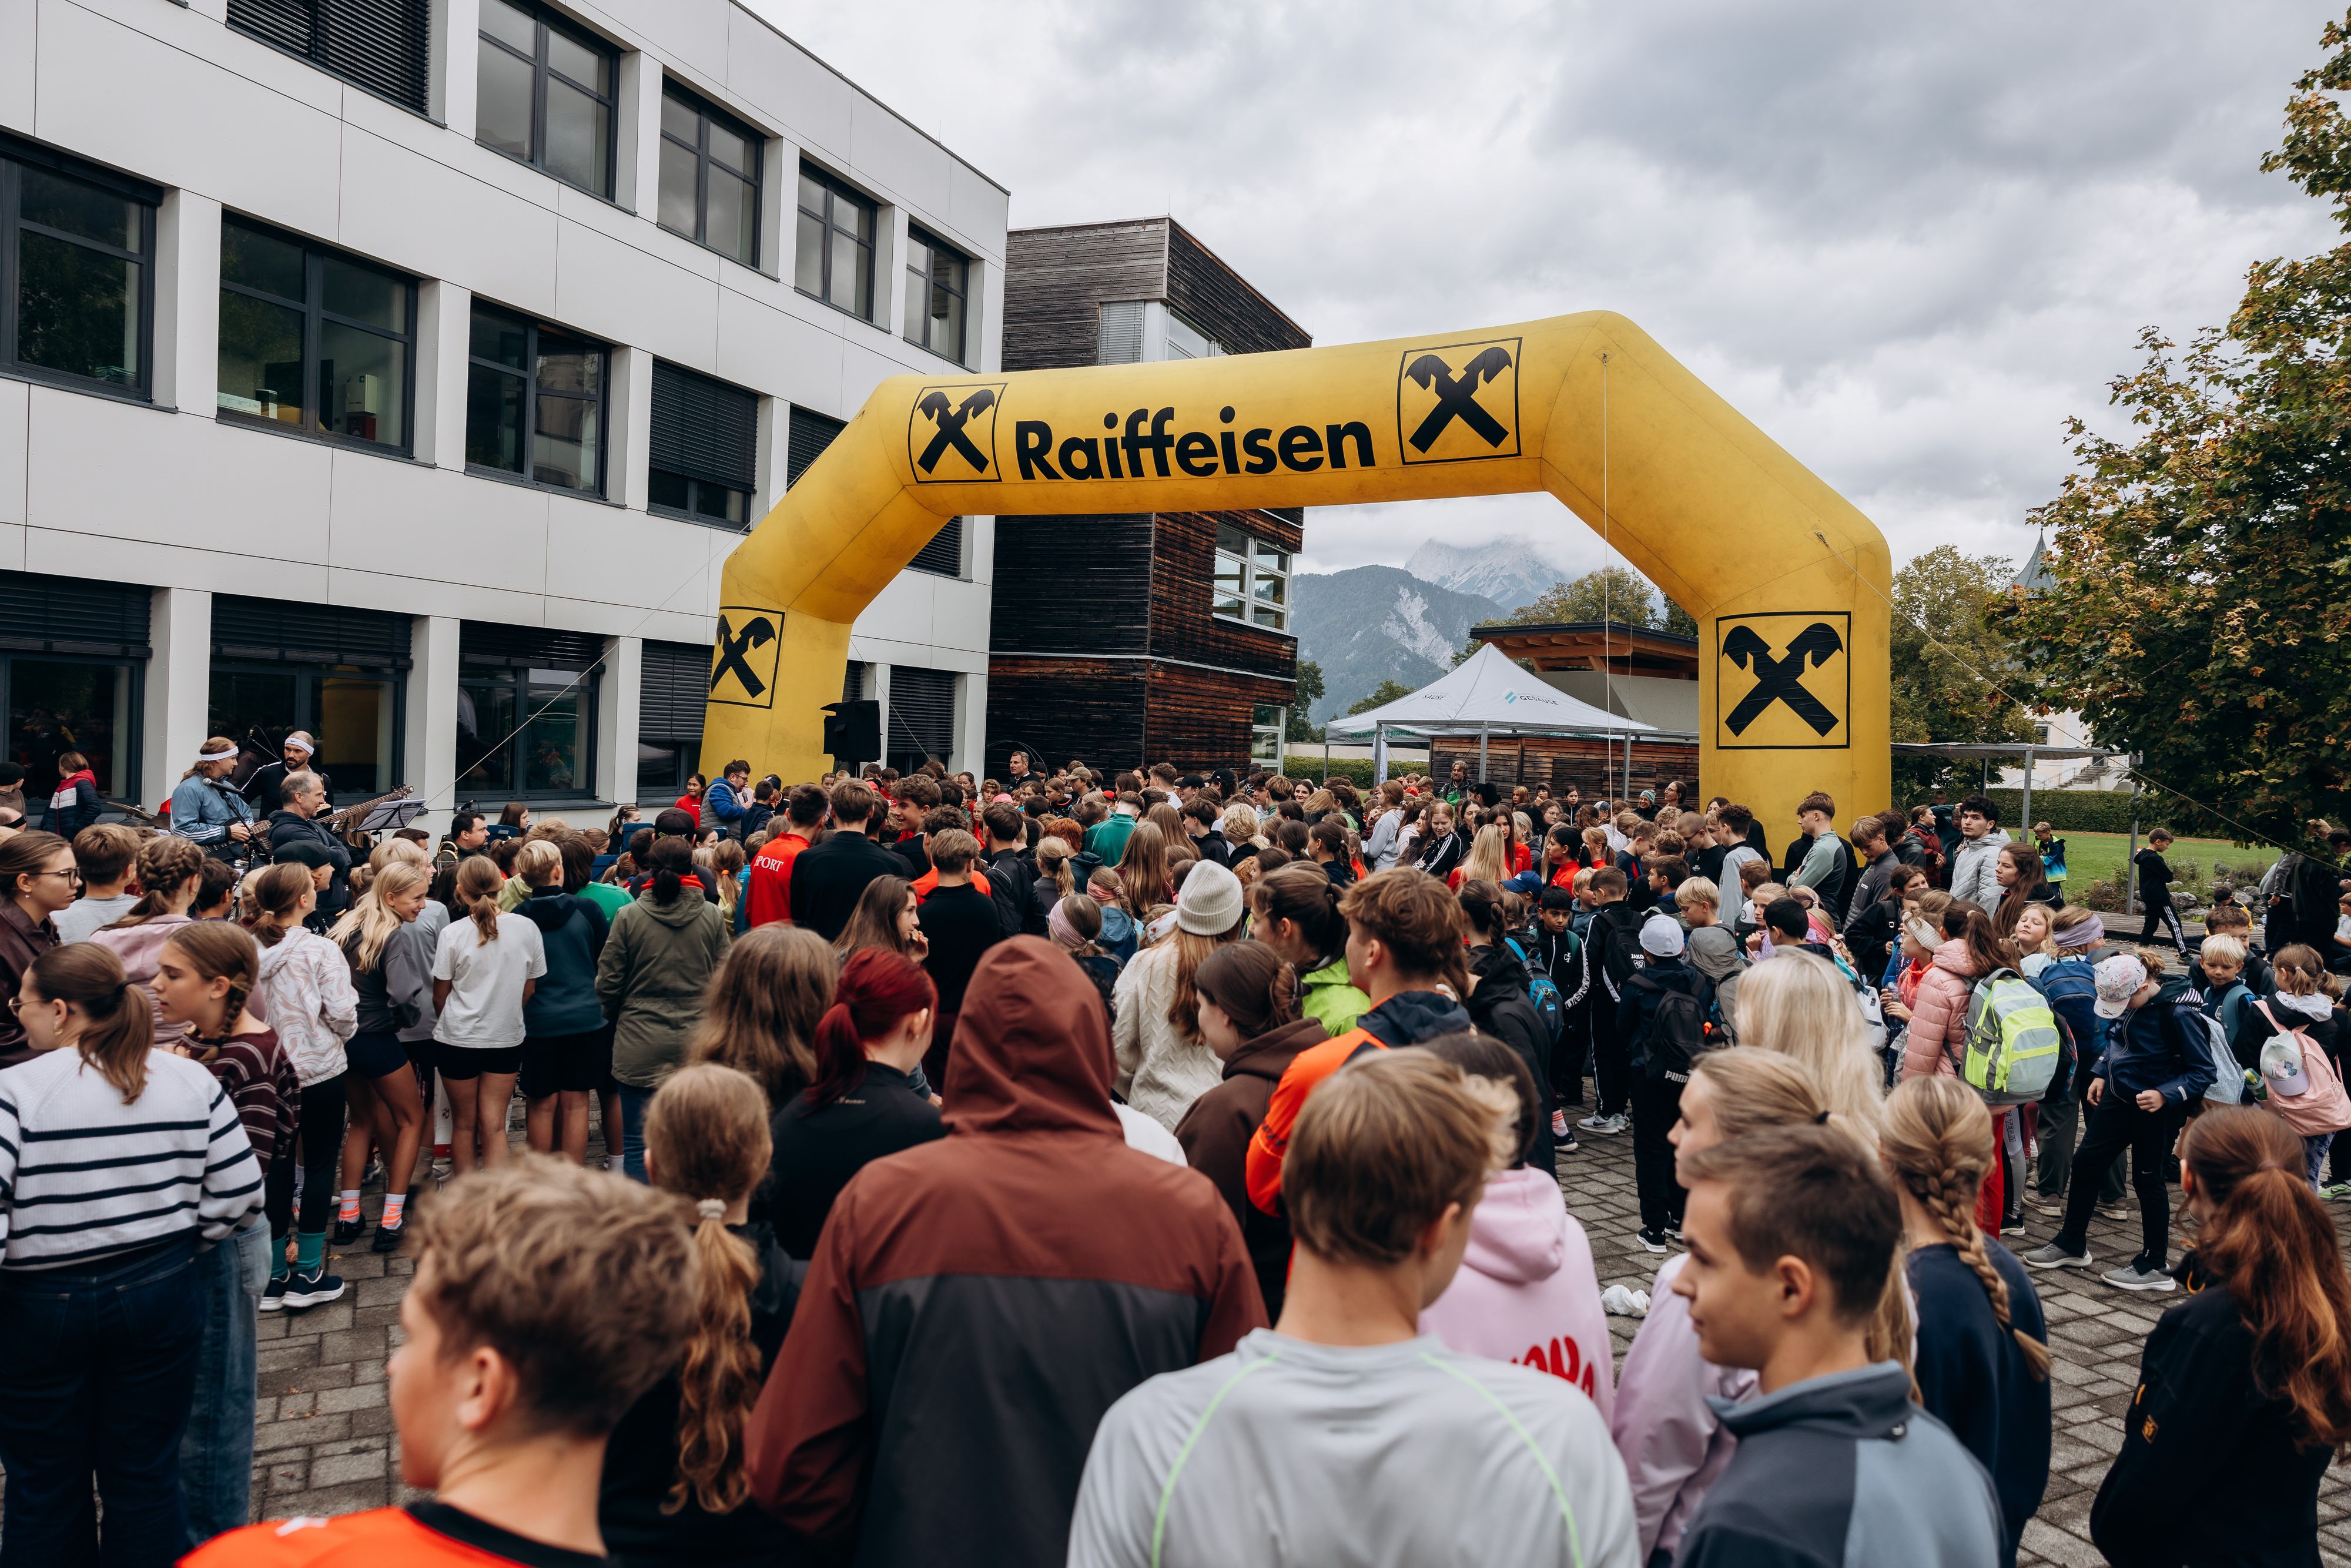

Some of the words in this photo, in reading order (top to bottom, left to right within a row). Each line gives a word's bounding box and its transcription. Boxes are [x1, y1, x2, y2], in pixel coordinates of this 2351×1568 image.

[1016, 406, 1377, 481] Raiffeisen
[1665, 1070, 1689, 1083] PUM
[2005, 1118, 2017, 1143] TEAM
